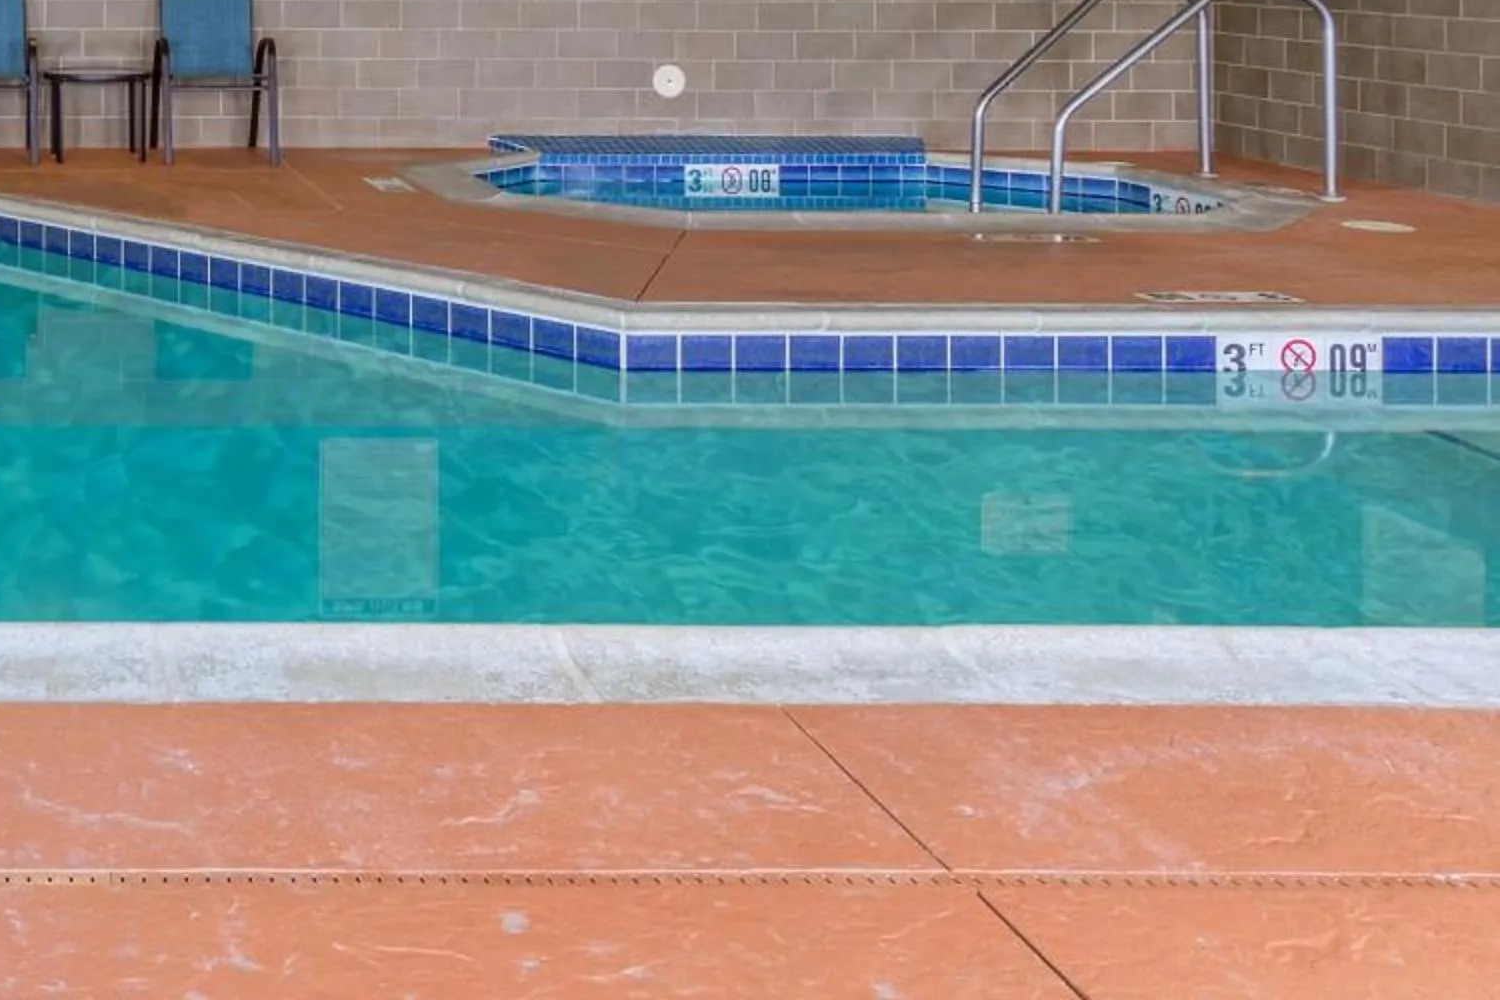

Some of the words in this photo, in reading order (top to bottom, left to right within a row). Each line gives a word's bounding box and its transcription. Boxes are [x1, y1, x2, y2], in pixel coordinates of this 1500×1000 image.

[1223, 343, 1247, 373] 3
[1250, 343, 1265, 356] FT
[1330, 343, 1367, 373] 09
